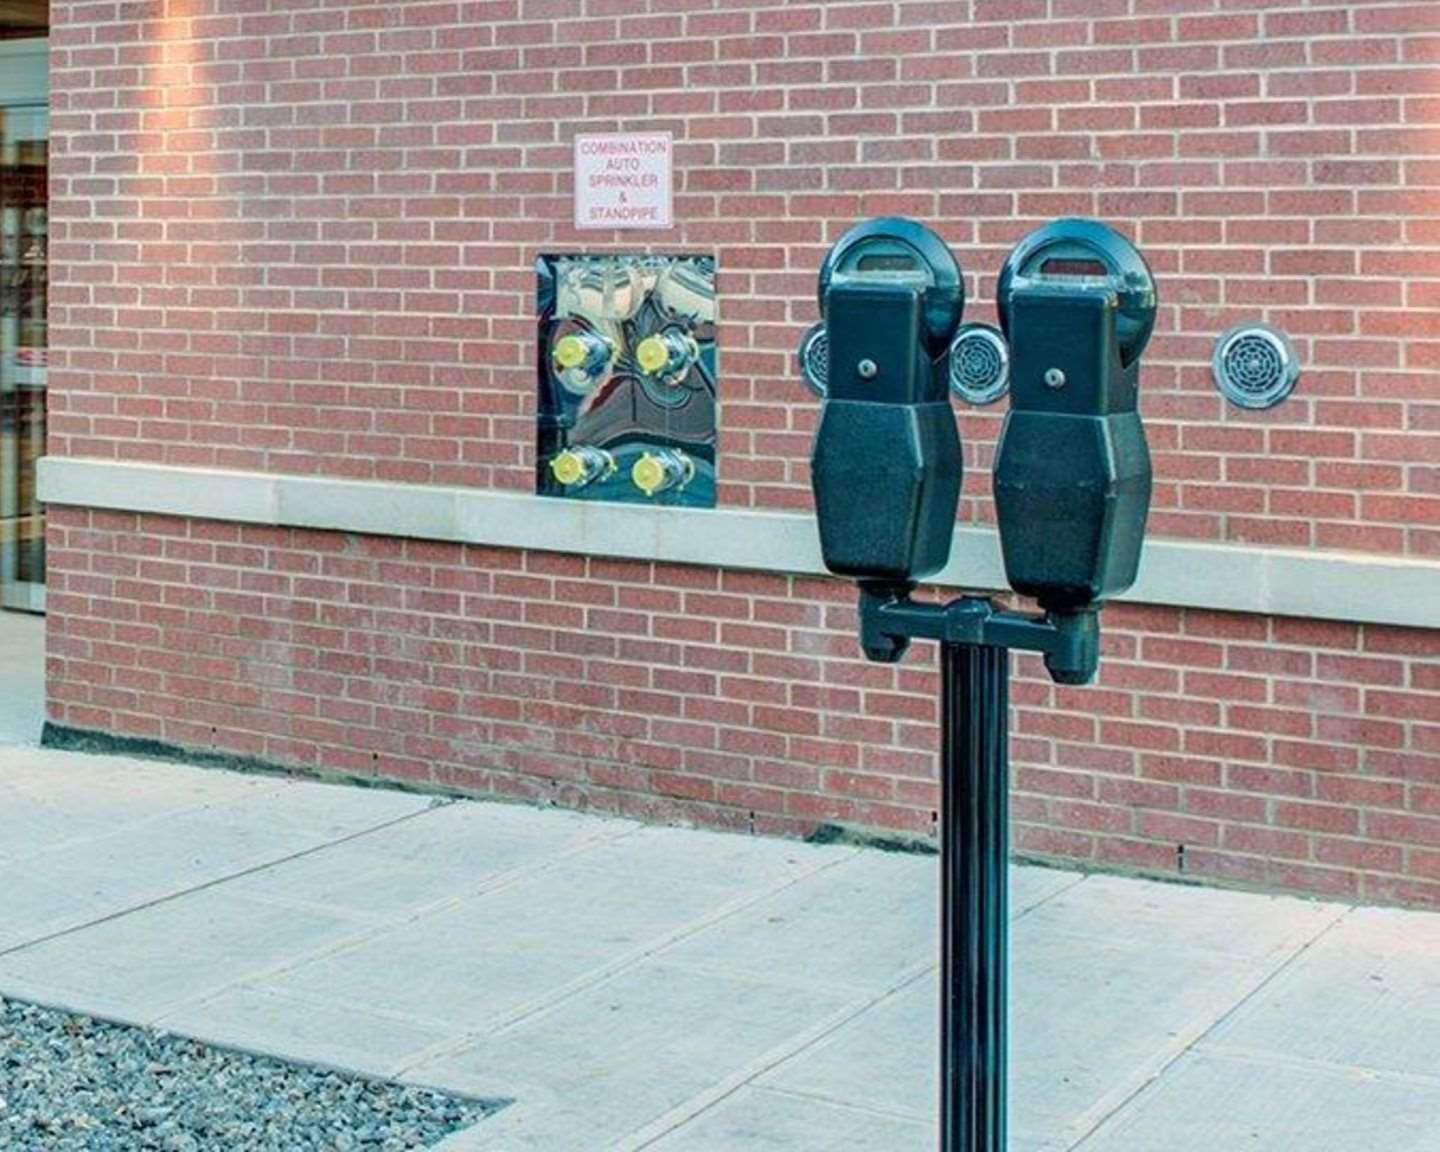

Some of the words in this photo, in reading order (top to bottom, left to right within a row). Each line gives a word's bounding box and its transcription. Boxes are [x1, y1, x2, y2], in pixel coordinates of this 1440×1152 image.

[580, 140, 667, 155] COMBINATION
[606, 157, 640, 171] AUTO
[589, 173, 658, 188] SPRINKLER
[589, 206, 658, 220] STANDPIPE
